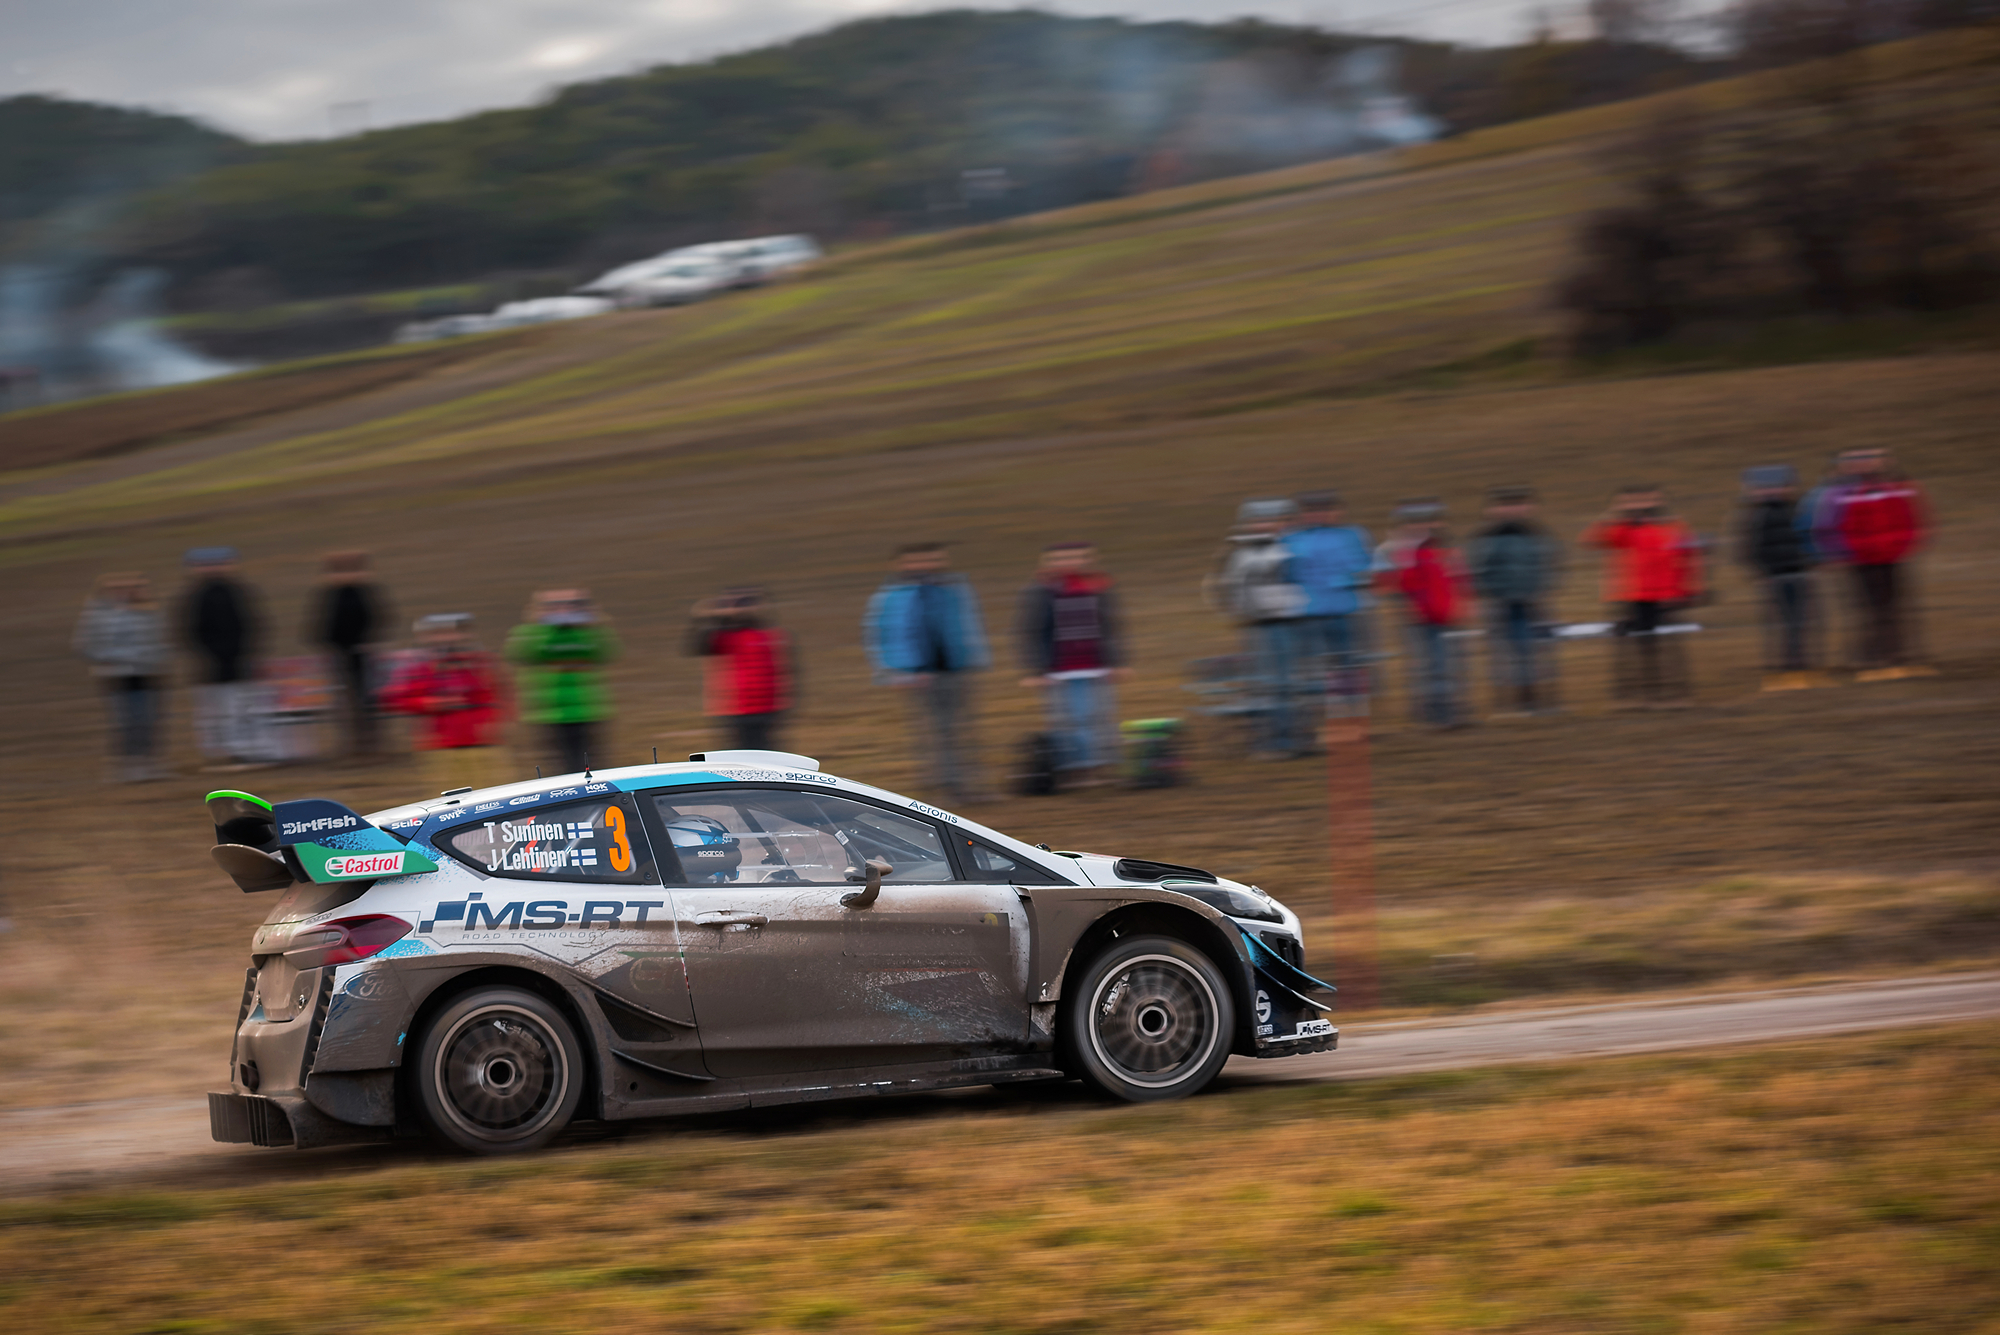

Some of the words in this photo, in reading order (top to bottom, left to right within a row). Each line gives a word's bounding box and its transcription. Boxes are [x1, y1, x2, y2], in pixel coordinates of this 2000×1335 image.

[584, 783, 608, 793] NGK
[785, 771, 837, 786] sparco
[908, 800, 958, 824] Acronis
[282, 815, 357, 836] DirtFish
[391, 817, 423, 830] Stilo
[483, 821, 496, 844] T
[500, 820, 564, 843] Suninen
[605, 805, 631, 873] 3
[345, 854, 399, 874] Castrol
[486, 848, 498, 872] J
[501, 846, 568, 871] Lehtinen
[462, 932, 501, 940] ROAD
[511, 931, 605, 939] TECHNOLOGY
